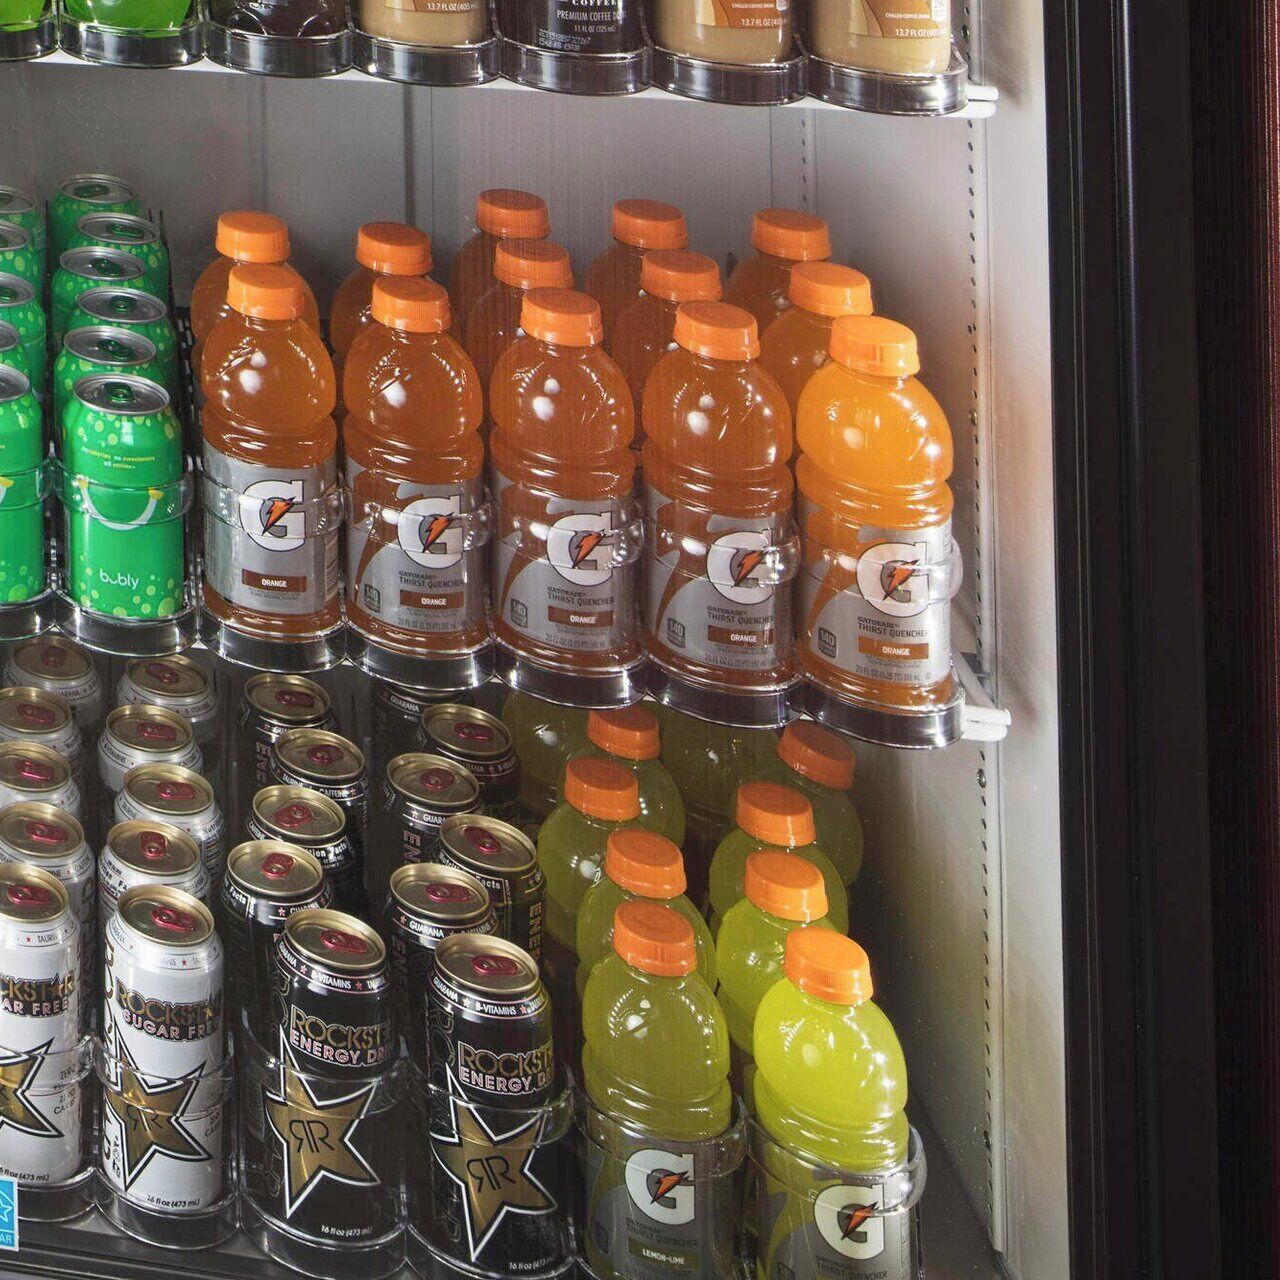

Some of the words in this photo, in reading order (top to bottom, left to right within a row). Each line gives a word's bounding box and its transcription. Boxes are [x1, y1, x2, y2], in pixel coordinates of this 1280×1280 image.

[239, 480, 305, 552] G
[397, 494, 463, 569] G
[546, 511, 614, 586] G
[99, 568, 139, 589] bubly
[262, 578, 288, 588] ORANGE
[399, 577, 426, 586] THIRST
[428, 579, 463, 588] QUENCHER
[856, 541, 929, 617] G
[421, 596, 447, 606] ORANGE
[858, 626, 887, 635] THIRST
[889, 628, 928, 638] QUENCHER
[882, 645, 910, 657] ORANGE
[409, 920, 445, 938] GUARANA
[311, 969, 352, 989] B-VITAMINS
[32, 998, 69, 1016] FREE
[475, 1002, 517, 1016] B-VITAMINS
[291, 1030, 364, 1065] ENERGY
[459, 1067, 533, 1093] ENERGY
[624, 1148, 695, 1225] G
[813, 1183, 885, 1260] G
[642, 1248, 686, 1265] LEMON-LIME
